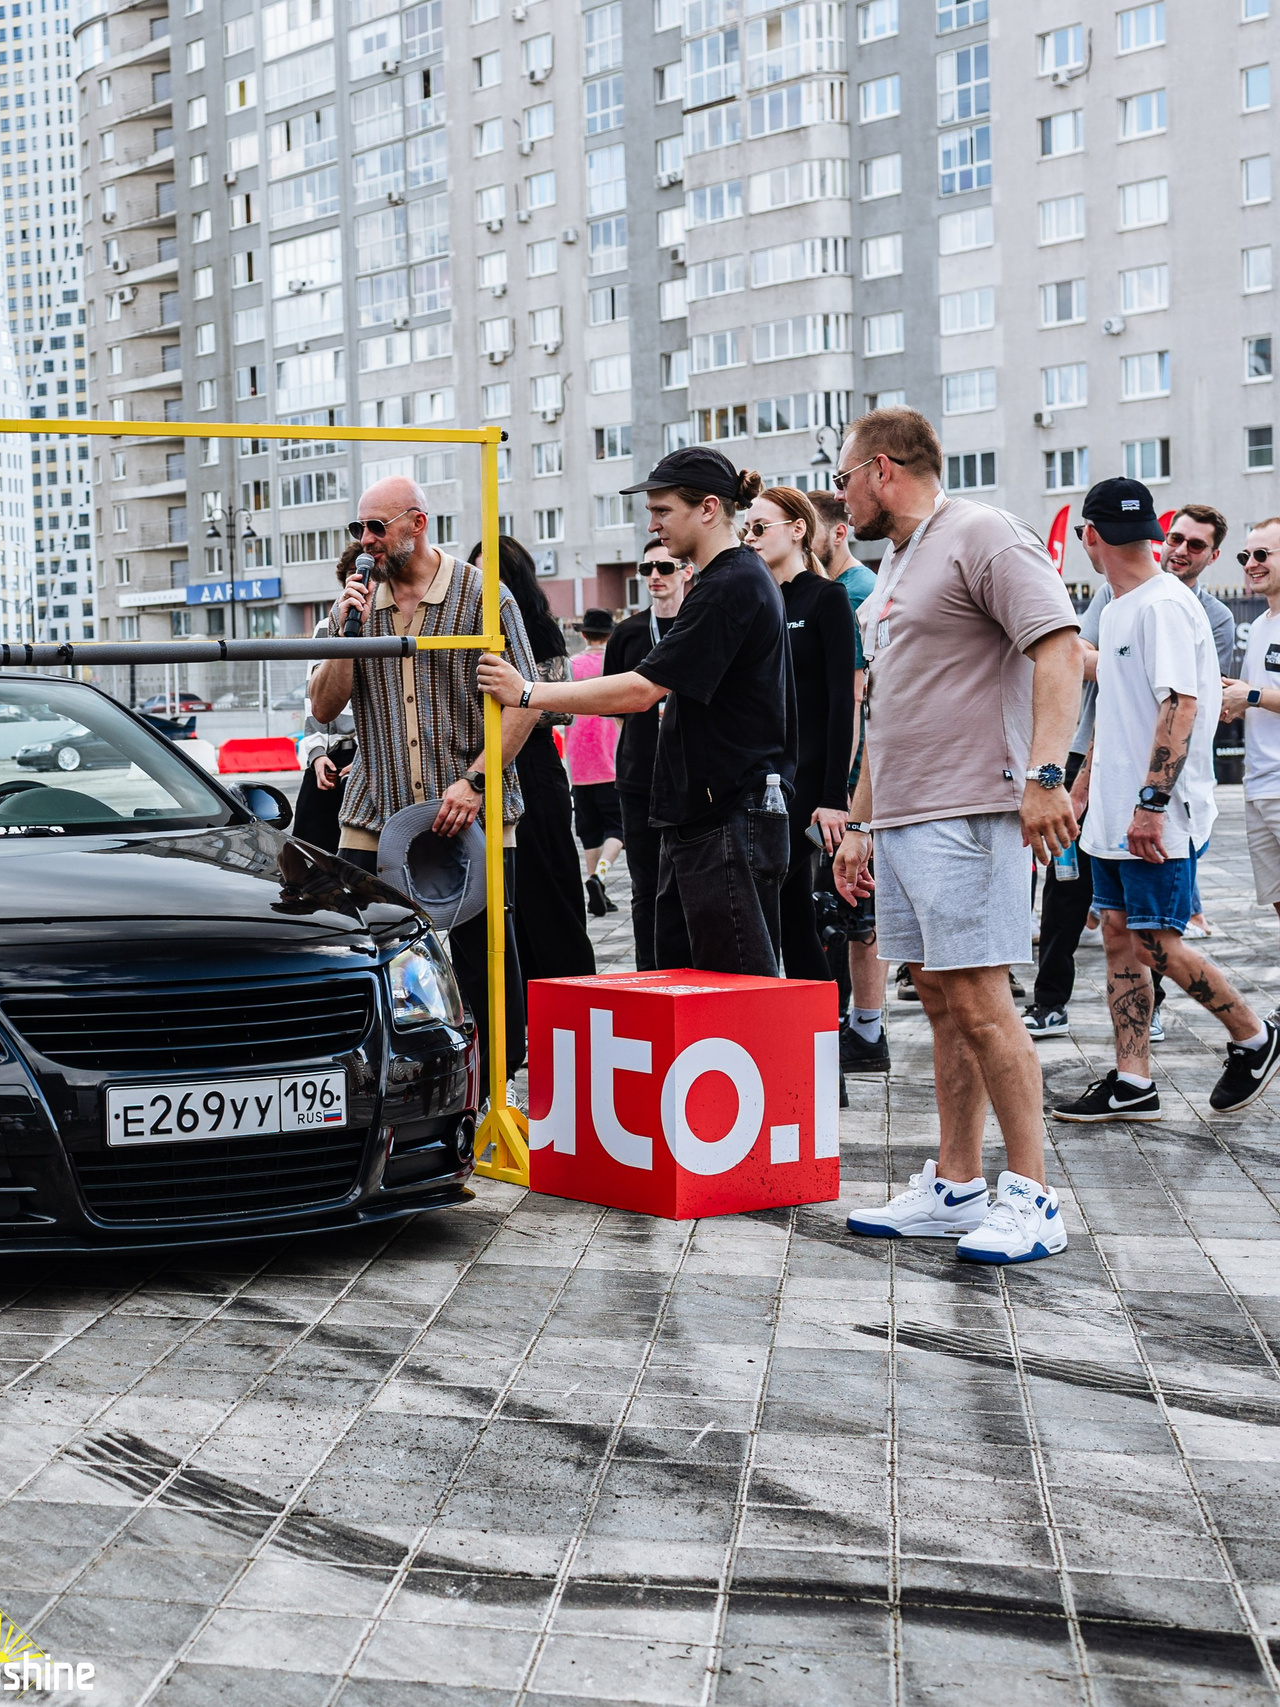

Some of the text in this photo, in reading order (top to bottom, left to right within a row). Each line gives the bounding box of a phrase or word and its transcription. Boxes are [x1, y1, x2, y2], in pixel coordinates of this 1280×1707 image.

[123, 1078, 336, 1137] Е269УУ 196
[297, 1111, 323, 1125] RUS
